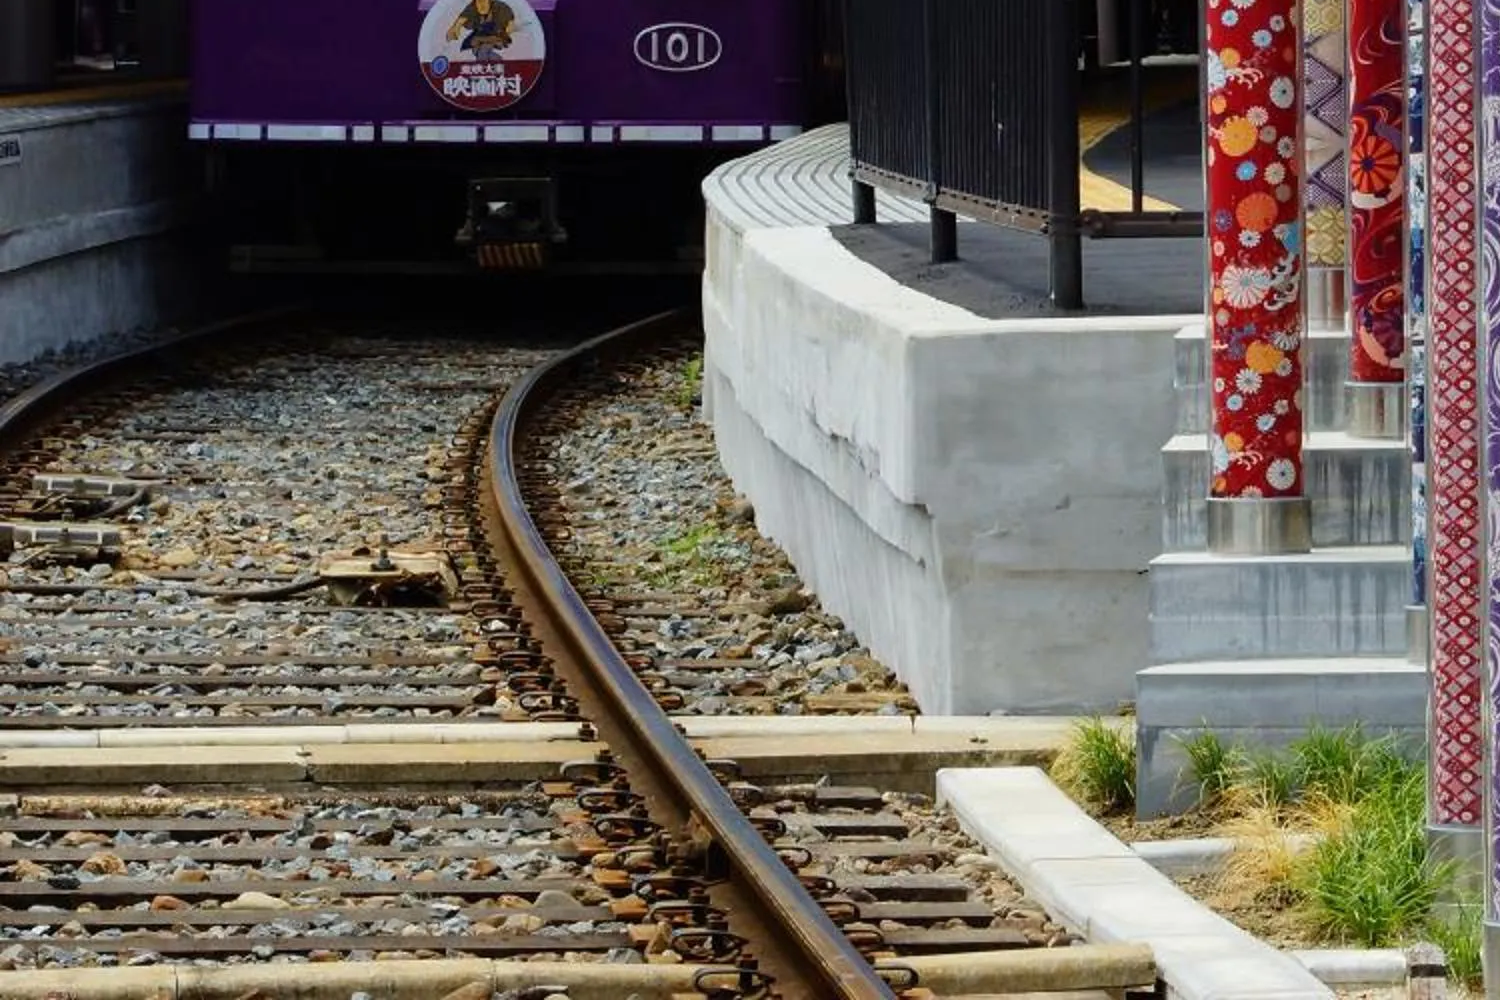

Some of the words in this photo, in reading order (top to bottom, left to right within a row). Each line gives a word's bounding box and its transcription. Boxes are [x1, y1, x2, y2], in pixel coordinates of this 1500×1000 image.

[651, 31, 705, 63] 101
[443, 74, 522, 97] 映画村
